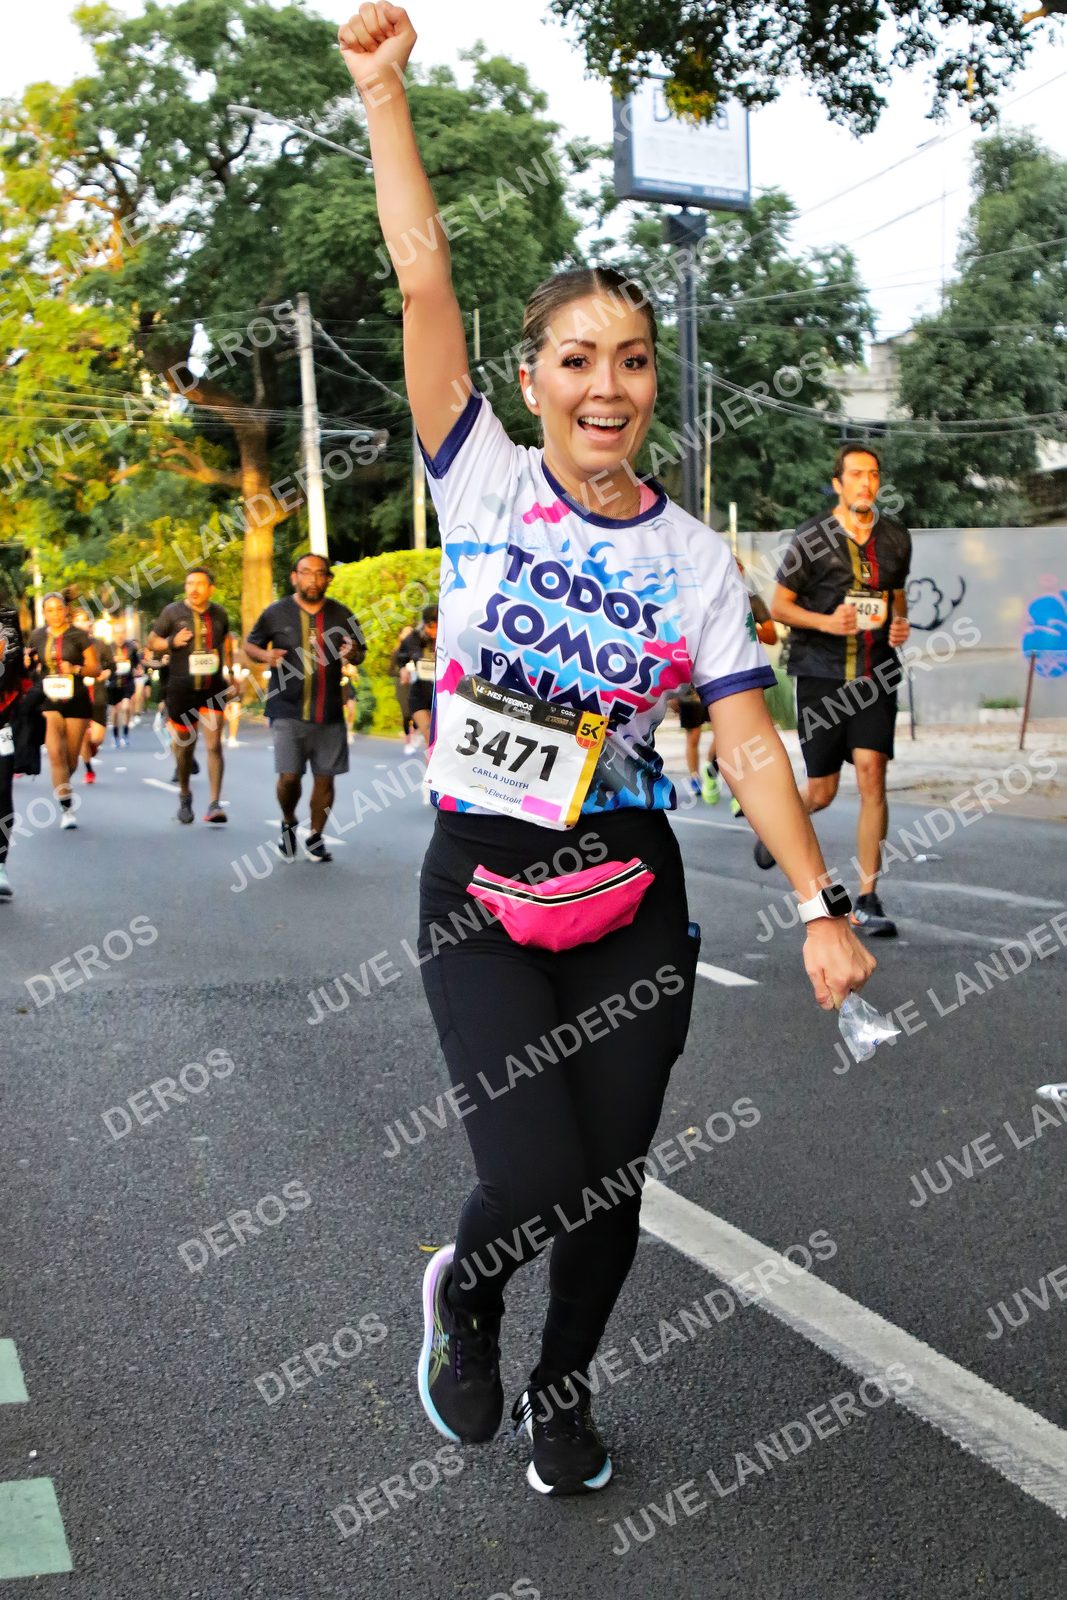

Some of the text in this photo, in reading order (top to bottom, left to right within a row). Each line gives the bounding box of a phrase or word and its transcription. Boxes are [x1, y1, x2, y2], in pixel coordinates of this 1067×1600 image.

[506, 544, 662, 640] TODOS
[850, 602, 879, 615] 403
[477, 593, 661, 694] SOMOS
[581, 723, 600, 739] 5K
[455, 718, 559, 782] 3471
[472, 766, 530, 790] CARLA JUDITH
[488, 788, 522, 805] Electrolit
